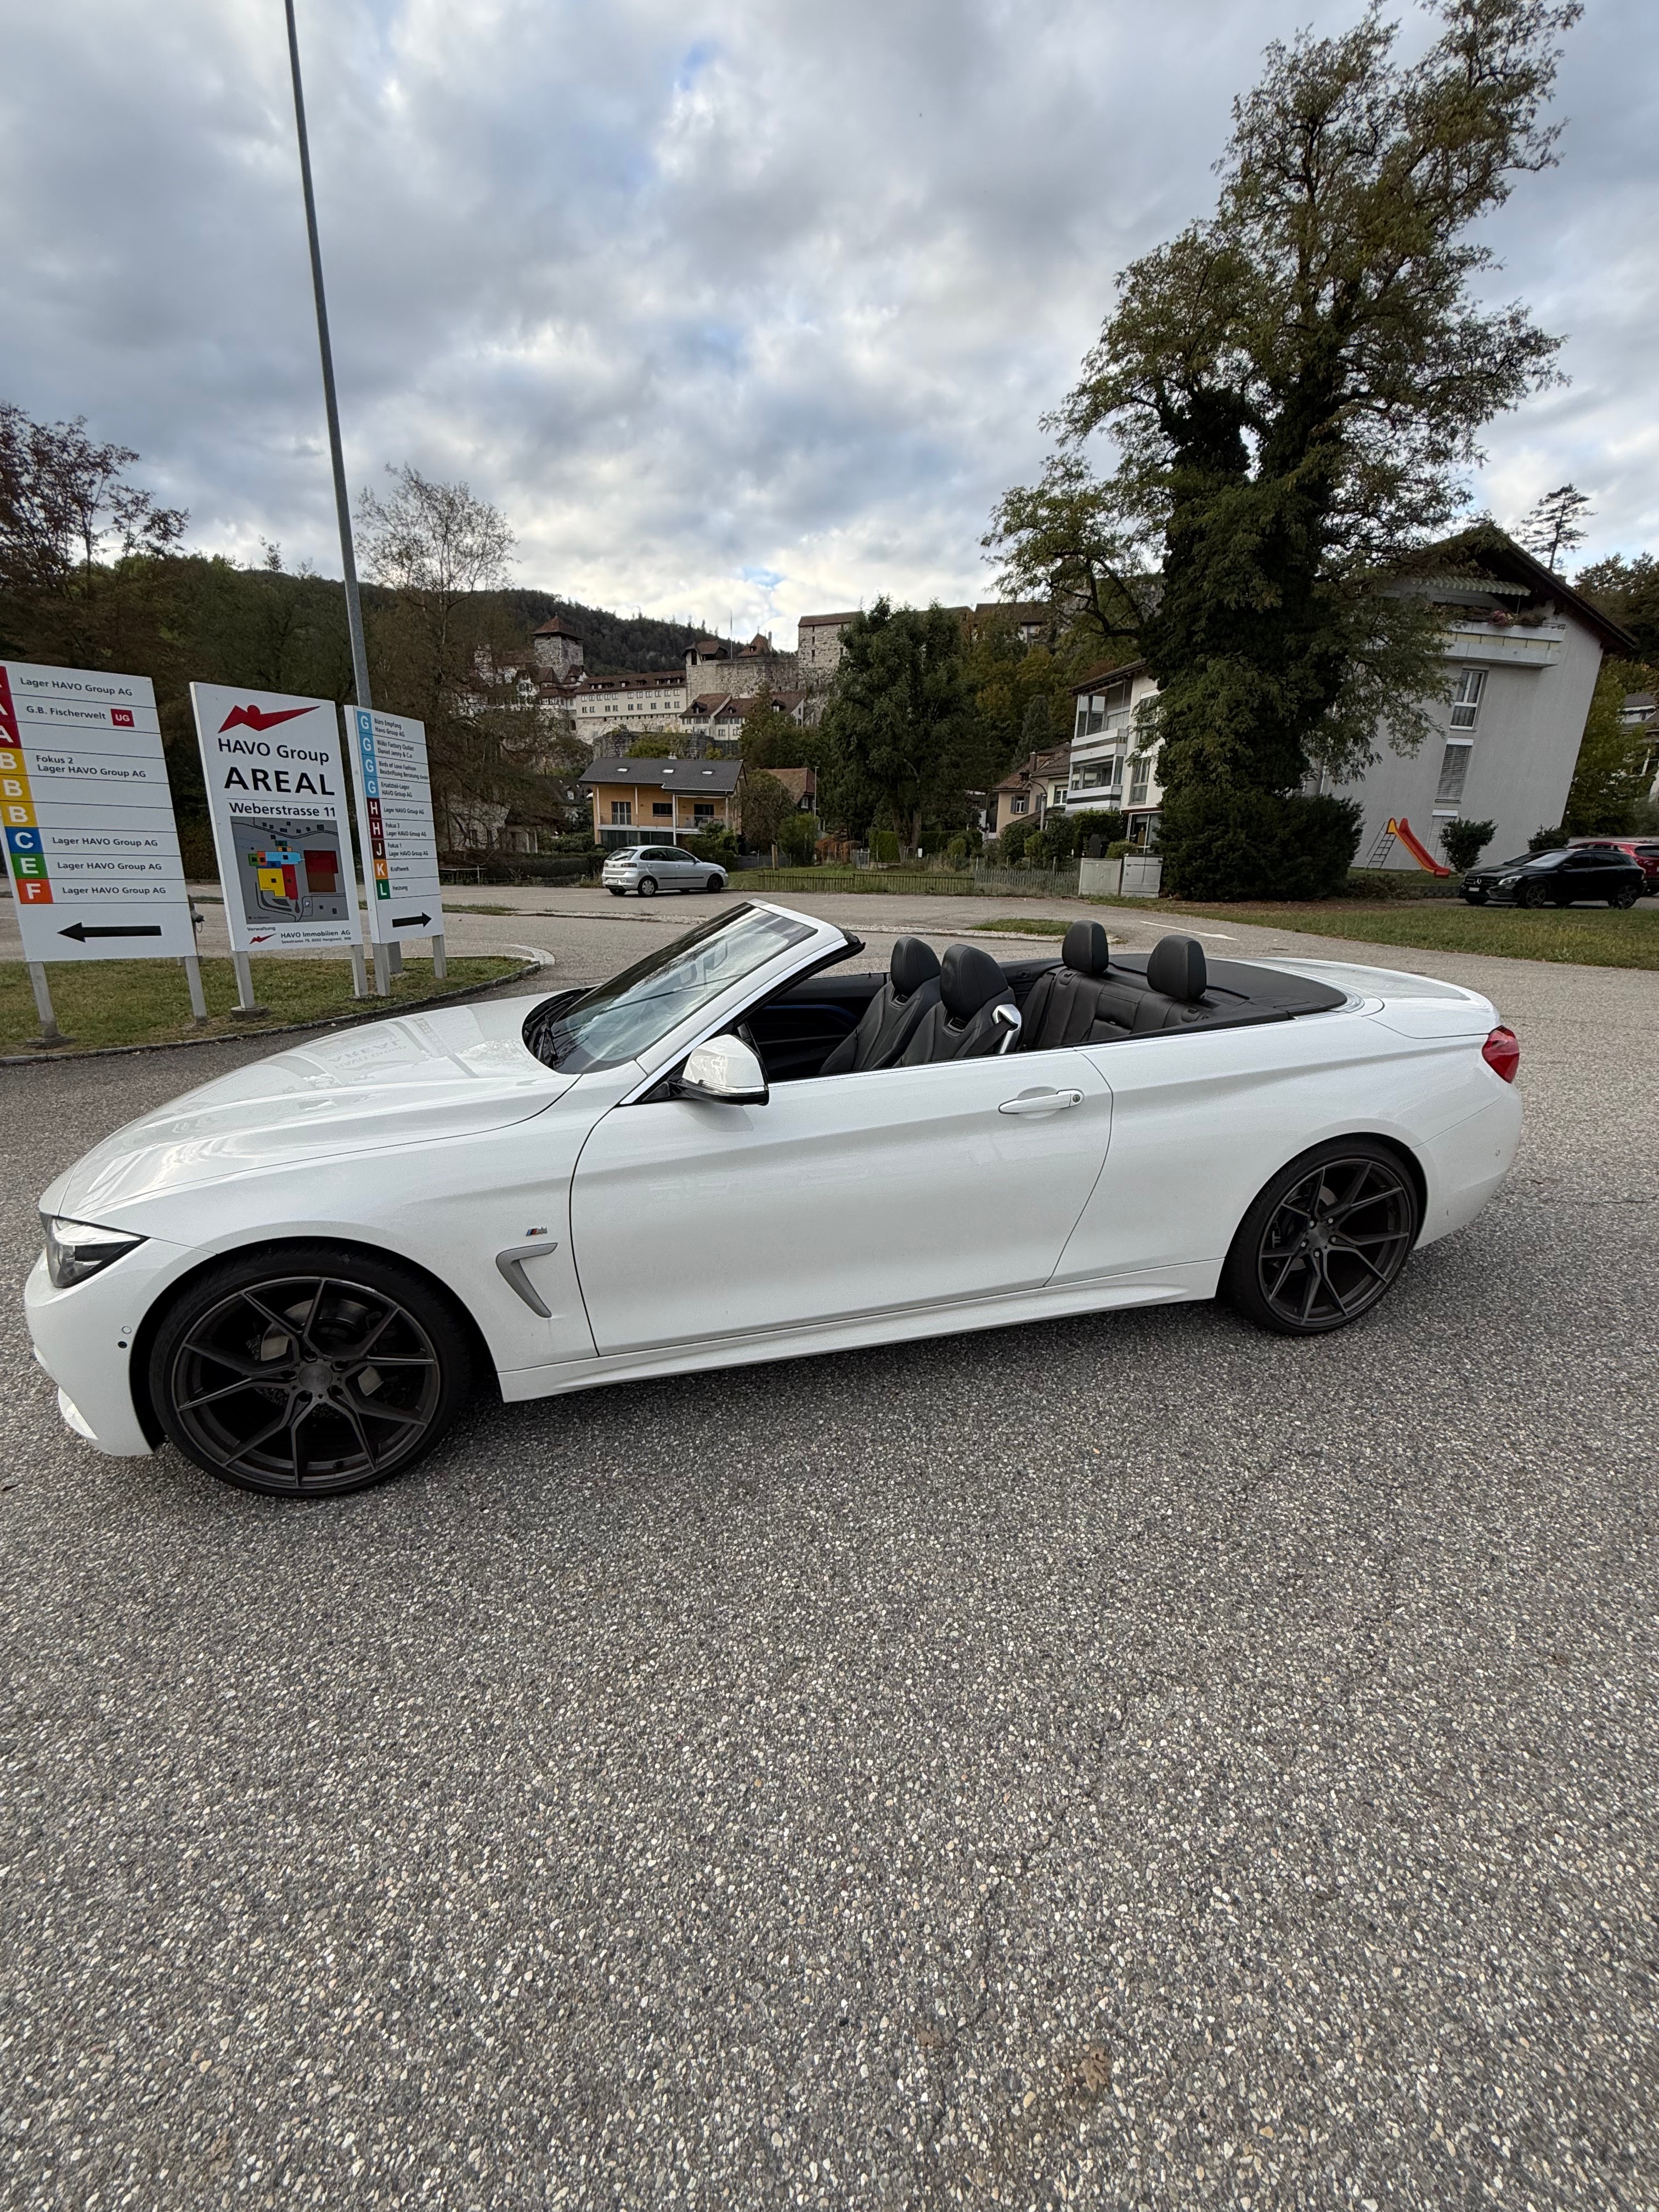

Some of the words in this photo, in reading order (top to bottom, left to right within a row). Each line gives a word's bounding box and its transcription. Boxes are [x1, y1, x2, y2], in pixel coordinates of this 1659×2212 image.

[20, 678, 48, 687] Lager
[52, 681, 82, 690] HAVO
[85, 685, 115, 695] Group
[26, 706, 48, 714] G.B.
[50, 708, 106, 719] Fischerwelt
[360, 715, 369, 729] G
[363, 737, 371, 751] G
[218, 738, 270, 757] HAVO
[276, 745, 329, 765] Group
[0, 752, 17, 769] B
[36, 755, 65, 764] Fokus
[365, 759, 374, 772] G
[38, 765, 65, 773] Lager
[69, 766, 97, 775] HAVO
[100, 769, 129, 777] Group
[224, 766, 335, 795] AREAL
[3, 779, 22, 797] B
[368, 781, 376, 794] G
[8, 806, 29, 822] B
[229, 802, 319, 816] Weberstrasse
[324, 807, 336, 817] 11
[370, 802, 378, 815] H
[373, 822, 380, 835] H
[15, 832, 33, 849] C
[53, 837, 79, 845] Lager
[114, 839, 142, 847] Group
[376, 843, 382, 855] J
[20, 857, 38, 874] E
[58, 862, 83, 870] Lager
[377, 863, 385, 876] K
[26, 883, 41, 899] F
[62, 887, 88, 895] Lager
[380, 883, 387, 895] L
